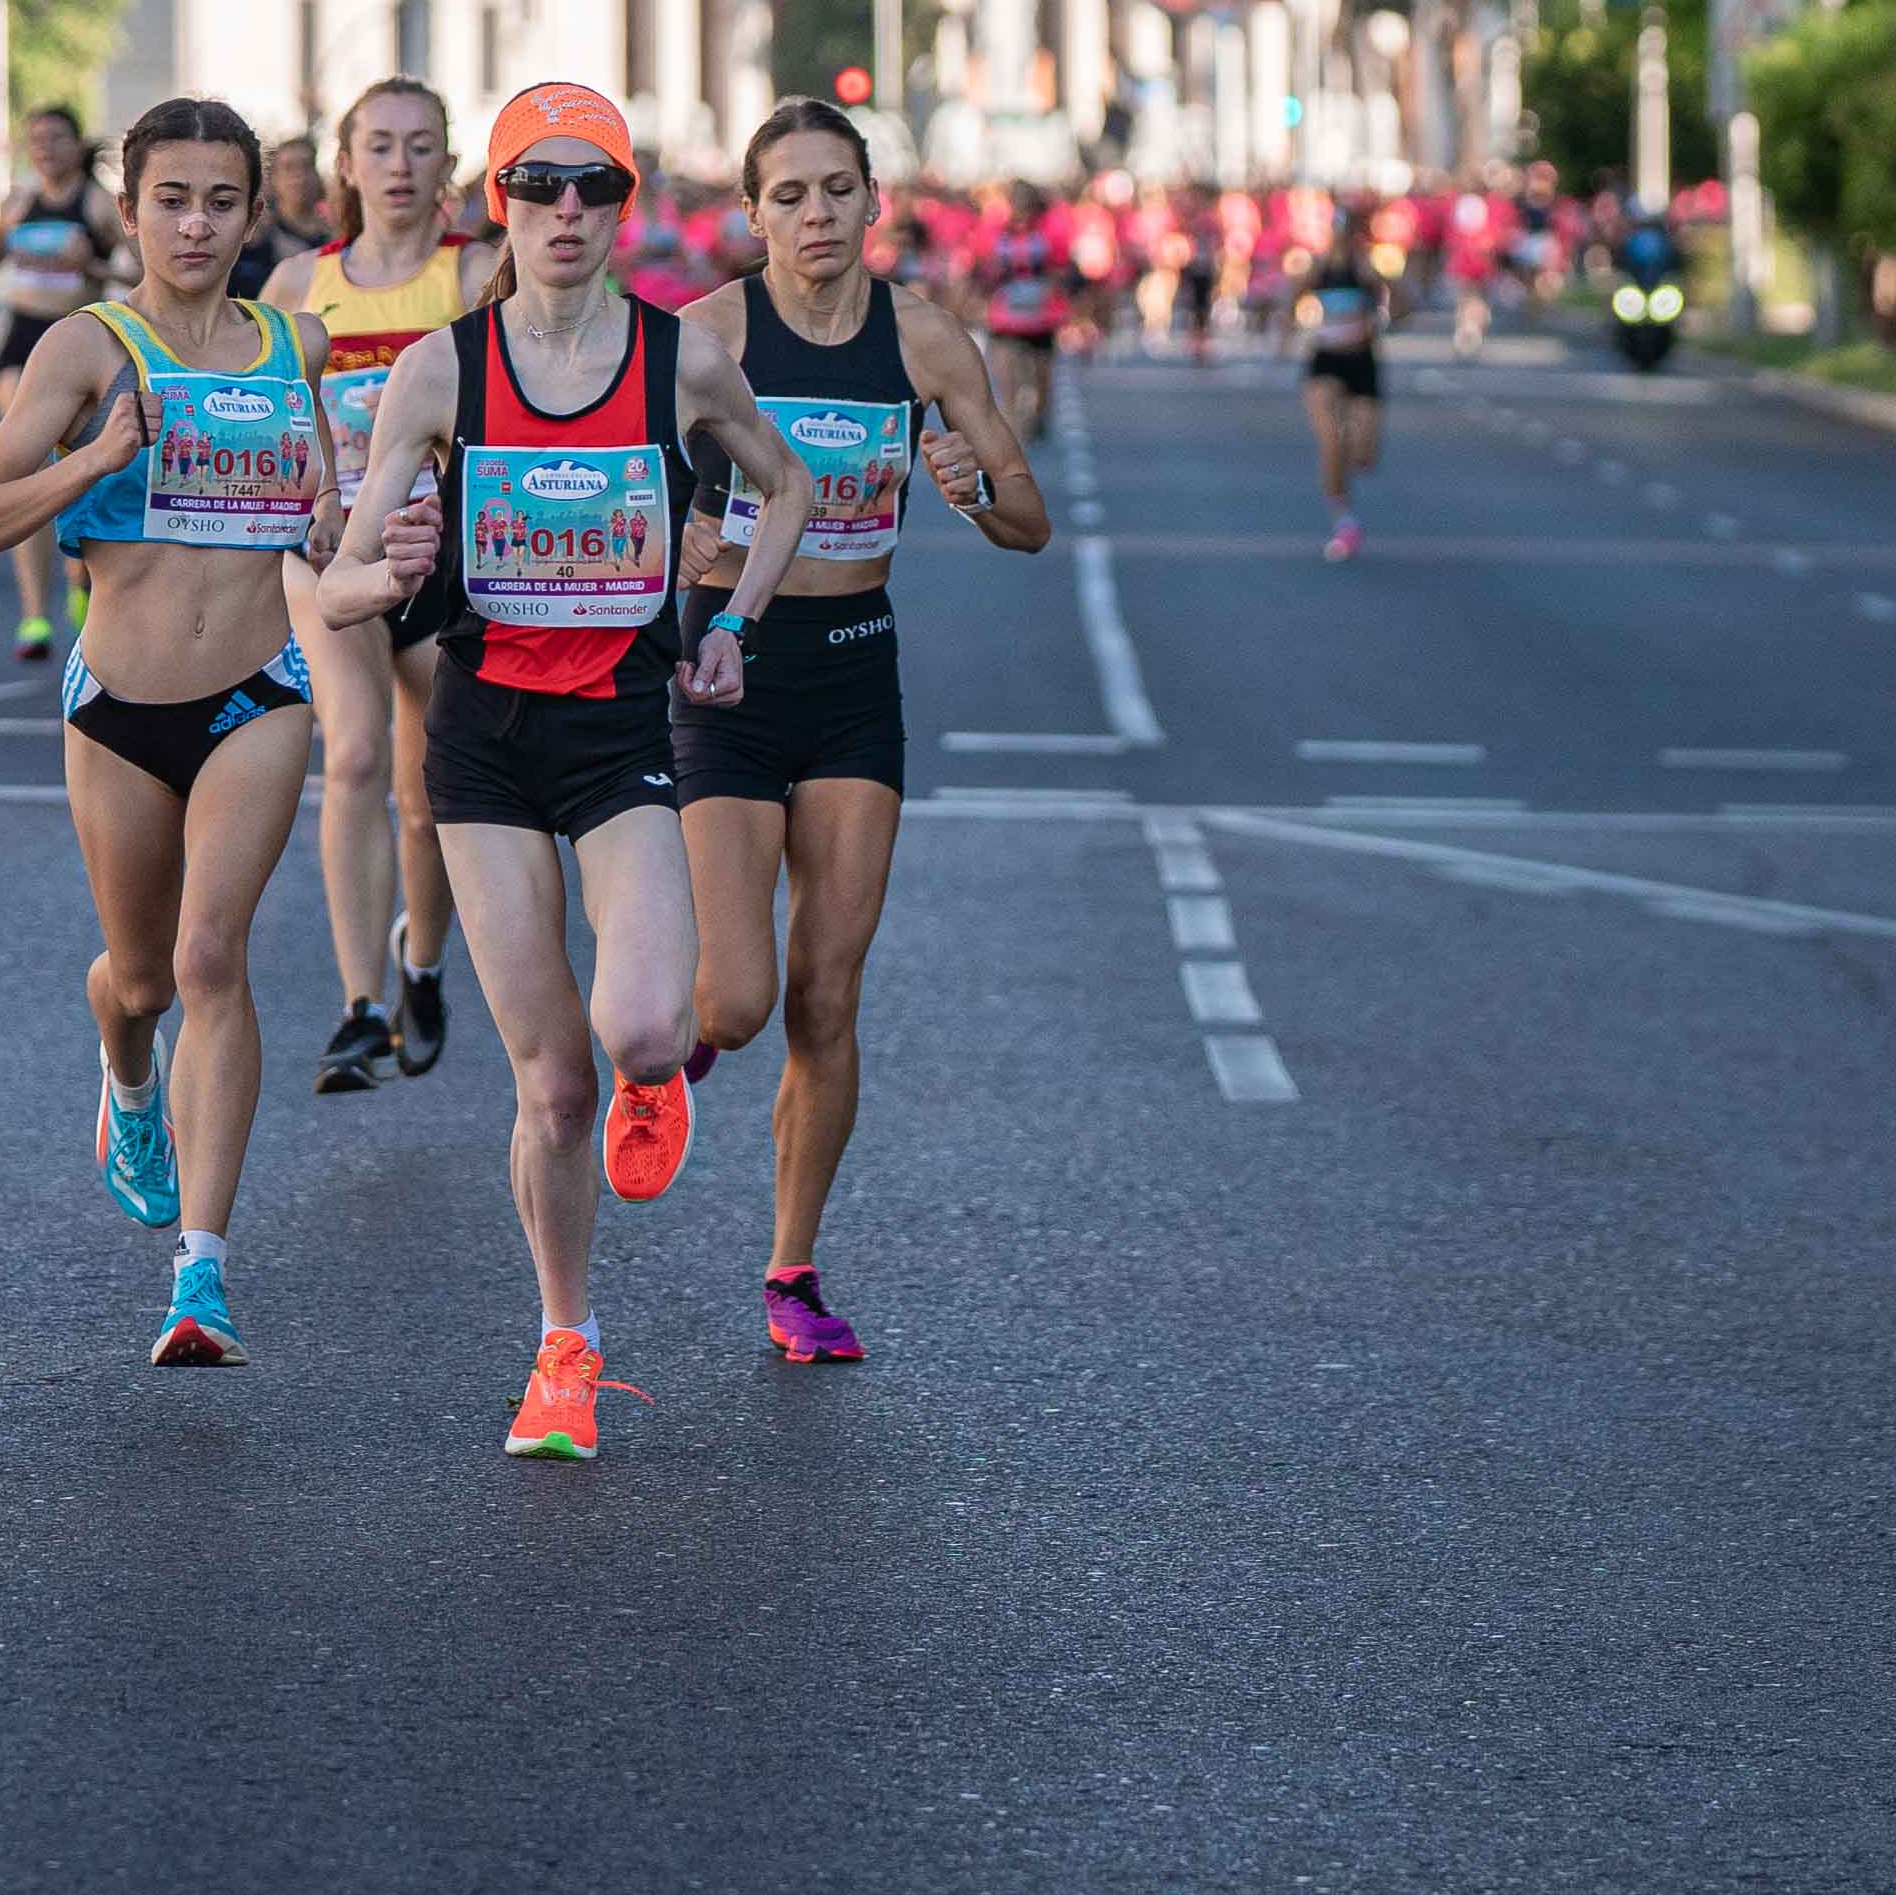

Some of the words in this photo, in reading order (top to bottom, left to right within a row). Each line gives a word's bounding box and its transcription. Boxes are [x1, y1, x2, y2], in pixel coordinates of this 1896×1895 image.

[208, 396, 271, 414] ASTURIANA
[796, 423, 862, 441] ASTURIANA
[214, 448, 275, 476] 016
[477, 466, 508, 477] SUMA
[528, 474, 603, 490] ASTURIANA
[817, 474, 858, 500] 16
[223, 484, 261, 497] 17447
[170, 498, 211, 509] CARRERA
[214, 500, 225, 509] DE
[227, 500, 239, 510] LA
[167, 517, 225, 532] OYSHO
[531, 528, 605, 557] 016
[556, 566, 574, 578] 40
[488, 581, 532, 592] CARRERA
[534, 583, 547, 592] DE
[549, 583, 561, 592] LA
[564, 582, 597, 592] MUJER
[605, 581, 645, 591] MADRID
[488, 601, 549, 616] OYSHO
[588, 604, 648, 615] Santander
[828, 615, 893, 644] OYSHO
